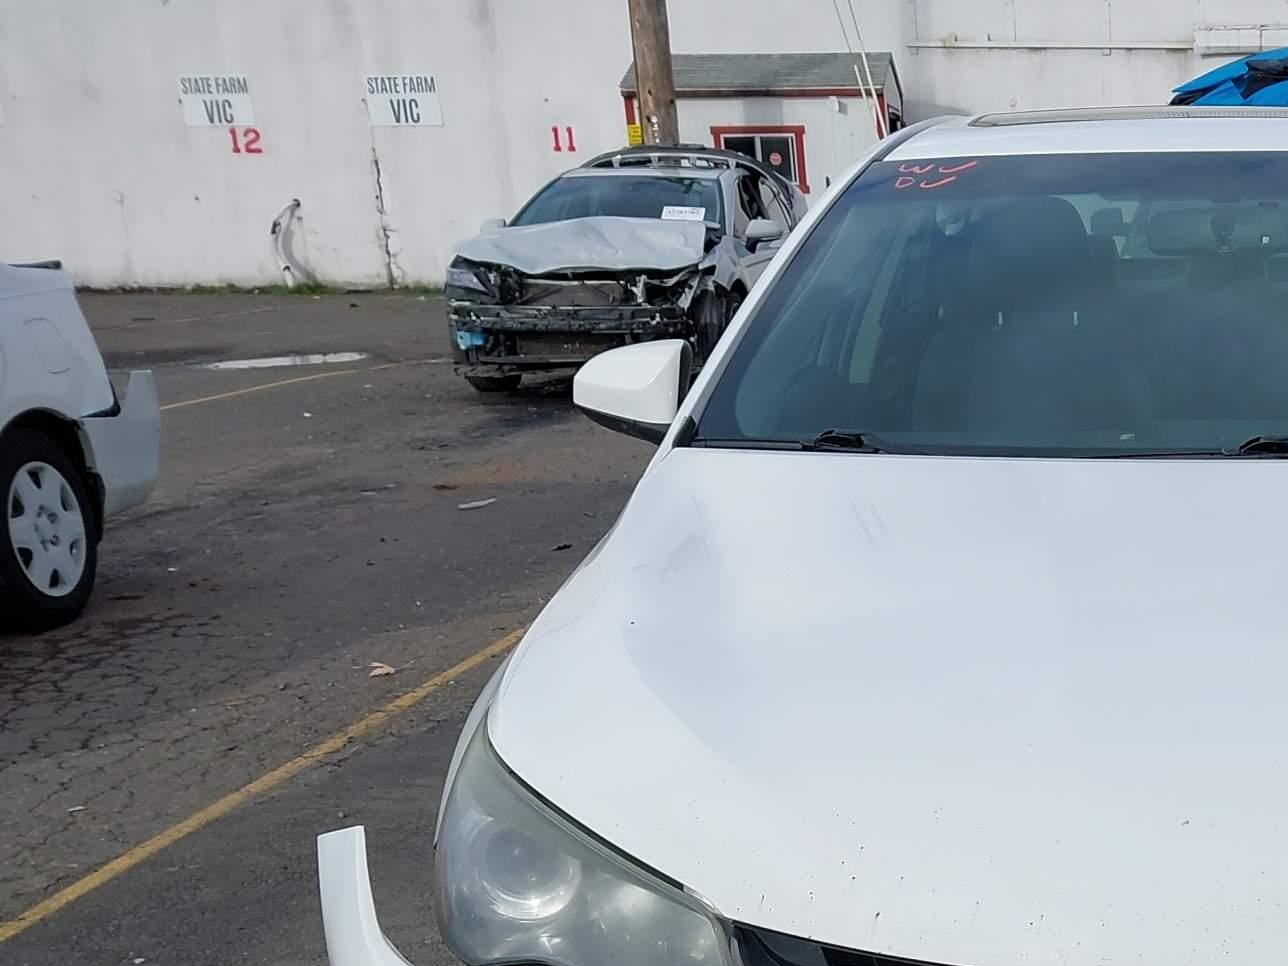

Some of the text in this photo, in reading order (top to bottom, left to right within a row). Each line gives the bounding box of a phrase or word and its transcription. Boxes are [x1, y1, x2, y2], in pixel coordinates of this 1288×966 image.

[180, 76, 249, 95] STATE FARM
[367, 76, 436, 94] STATE FARM
[202, 99, 234, 124] VIC
[389, 98, 421, 124] VIC
[228, 127, 264, 154] 12
[551, 126, 577, 152] 11
